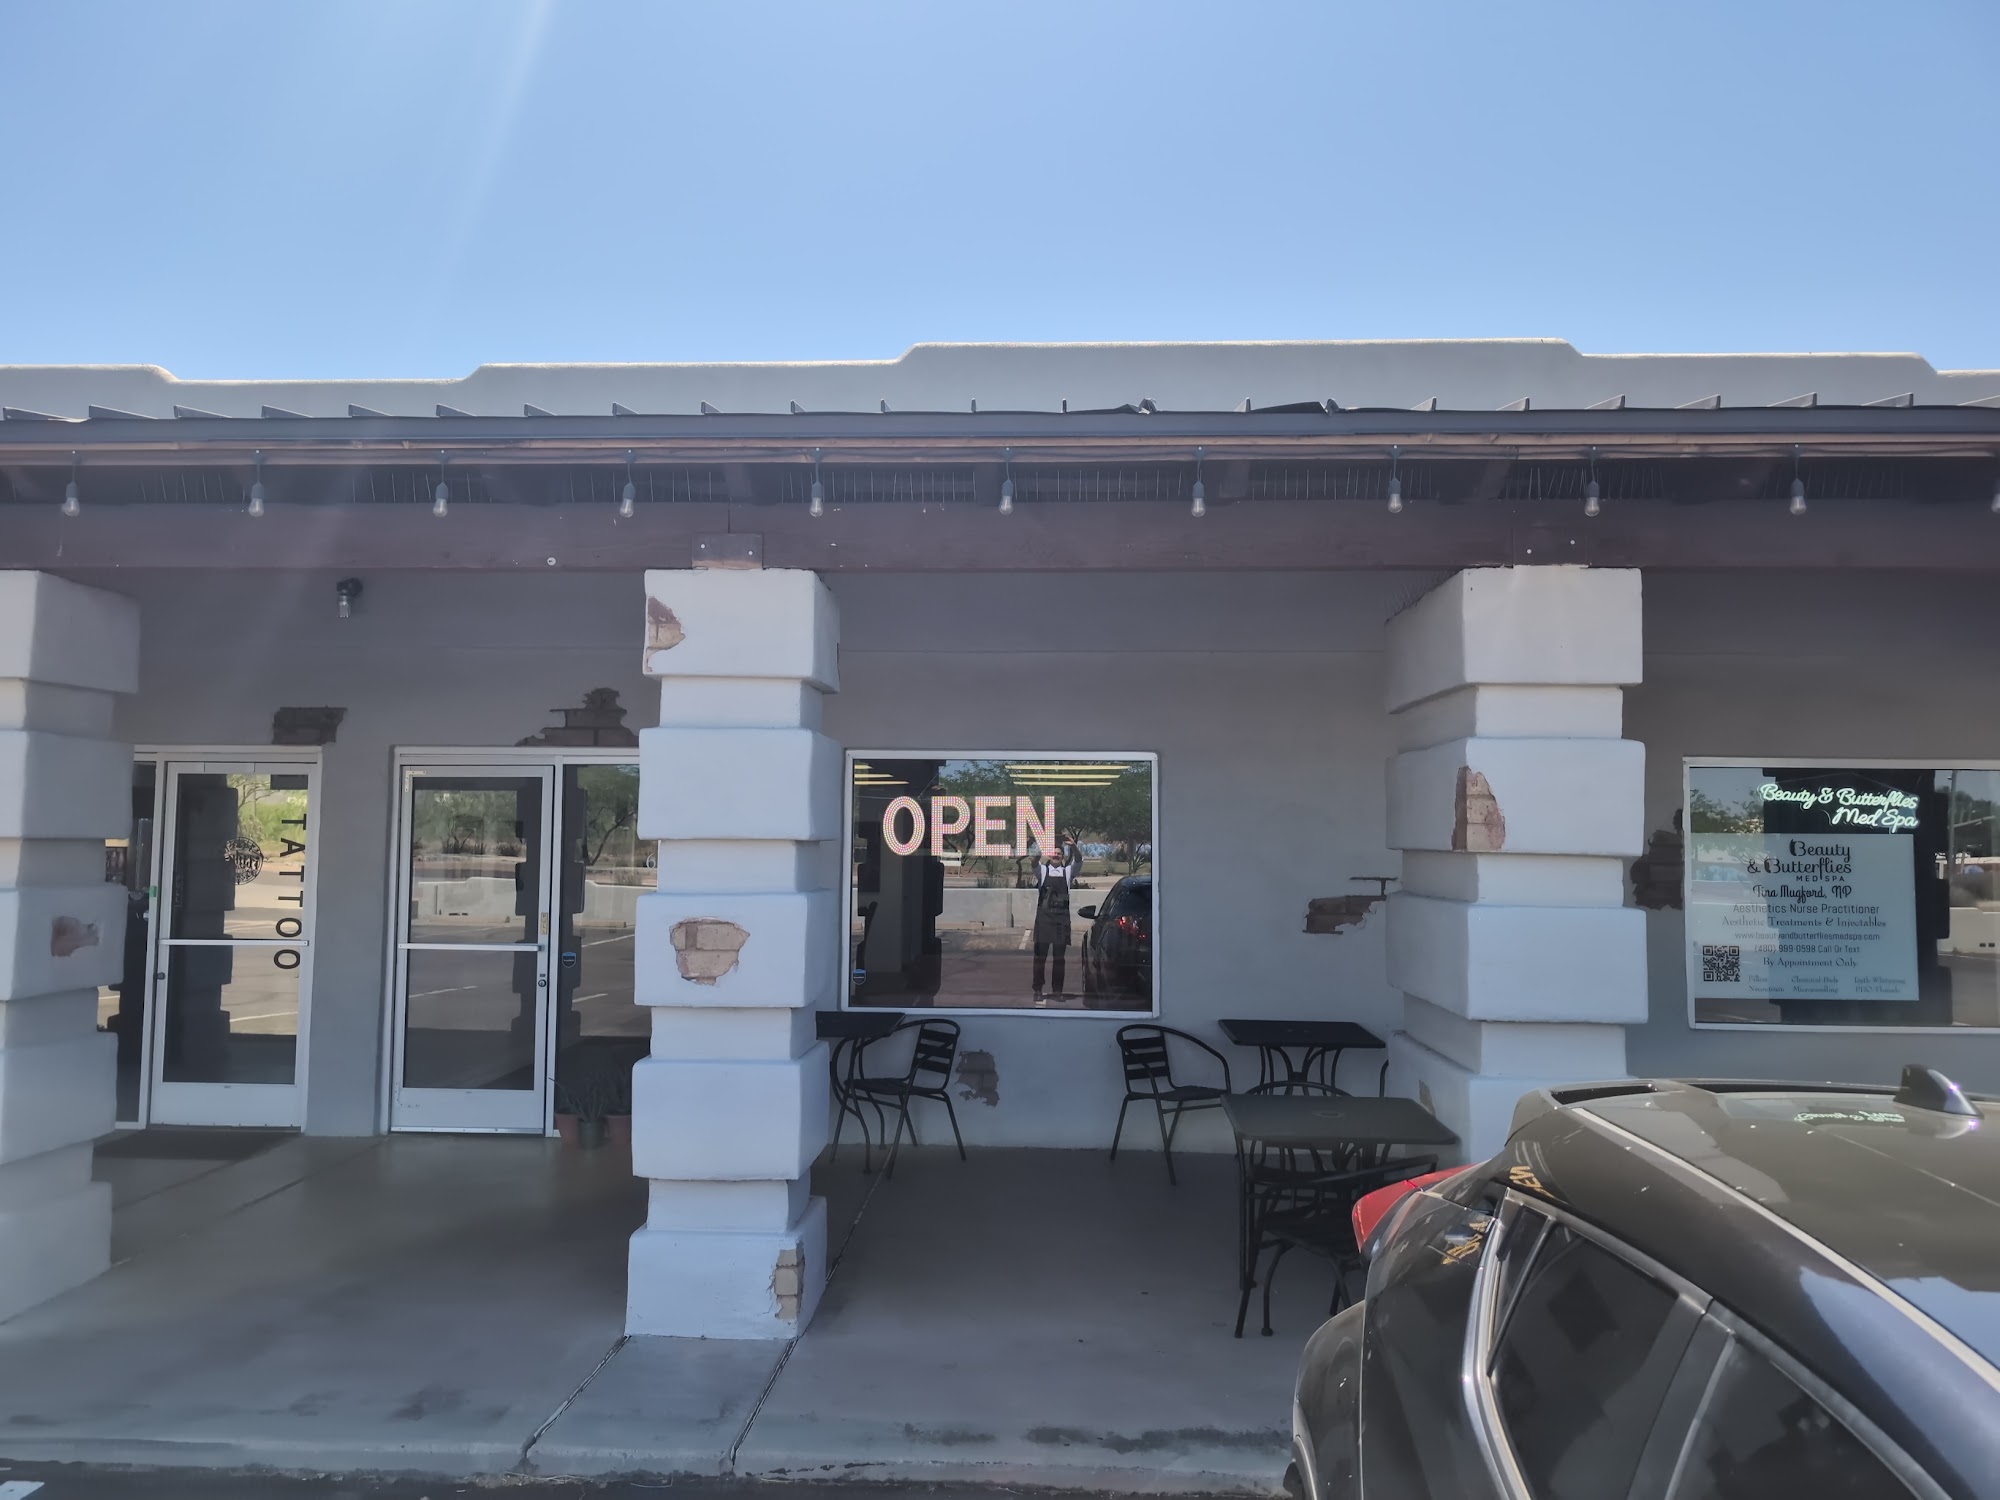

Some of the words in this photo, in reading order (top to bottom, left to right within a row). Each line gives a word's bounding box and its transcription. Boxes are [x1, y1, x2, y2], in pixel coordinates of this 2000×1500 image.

[1760, 784, 1818, 809] Beauty
[1818, 787, 1834, 803] &
[1836, 788, 1918, 811] Butterflies
[883, 796, 1055, 856] OPEN
[1832, 807, 1881, 825] Med
[1882, 809, 1918, 833] Spa
[1789, 838, 1850, 863] Beauty
[1747, 858, 1761, 873] &
[1764, 857, 1852, 880] Butterflies
[273, 813, 307, 969] TATTOO
[1752, 885, 1778, 898] Tina
[1780, 885, 1827, 903] Mugford,
[1831, 885, 1852, 898] NP
[1733, 904, 1787, 914] Aesthetics
[1790, 904, 1818, 914] Nurse
[1821, 904, 1880, 914] Practitioner
[1722, 917, 1764, 927] Aesthetic
[1767, 917, 1822, 927] Treatments
[1825, 917, 1834, 926] &
[1837, 917, 1886, 928] Injectables
[1754, 944, 1776, 953] (480)
[1817, 944, 1832, 953] Call
[1844, 945, 1860, 953] Text
[1763, 957, 1775, 968] By
[1777, 957, 1833, 968] Appointment
[1835, 957, 1857, 968] Only
